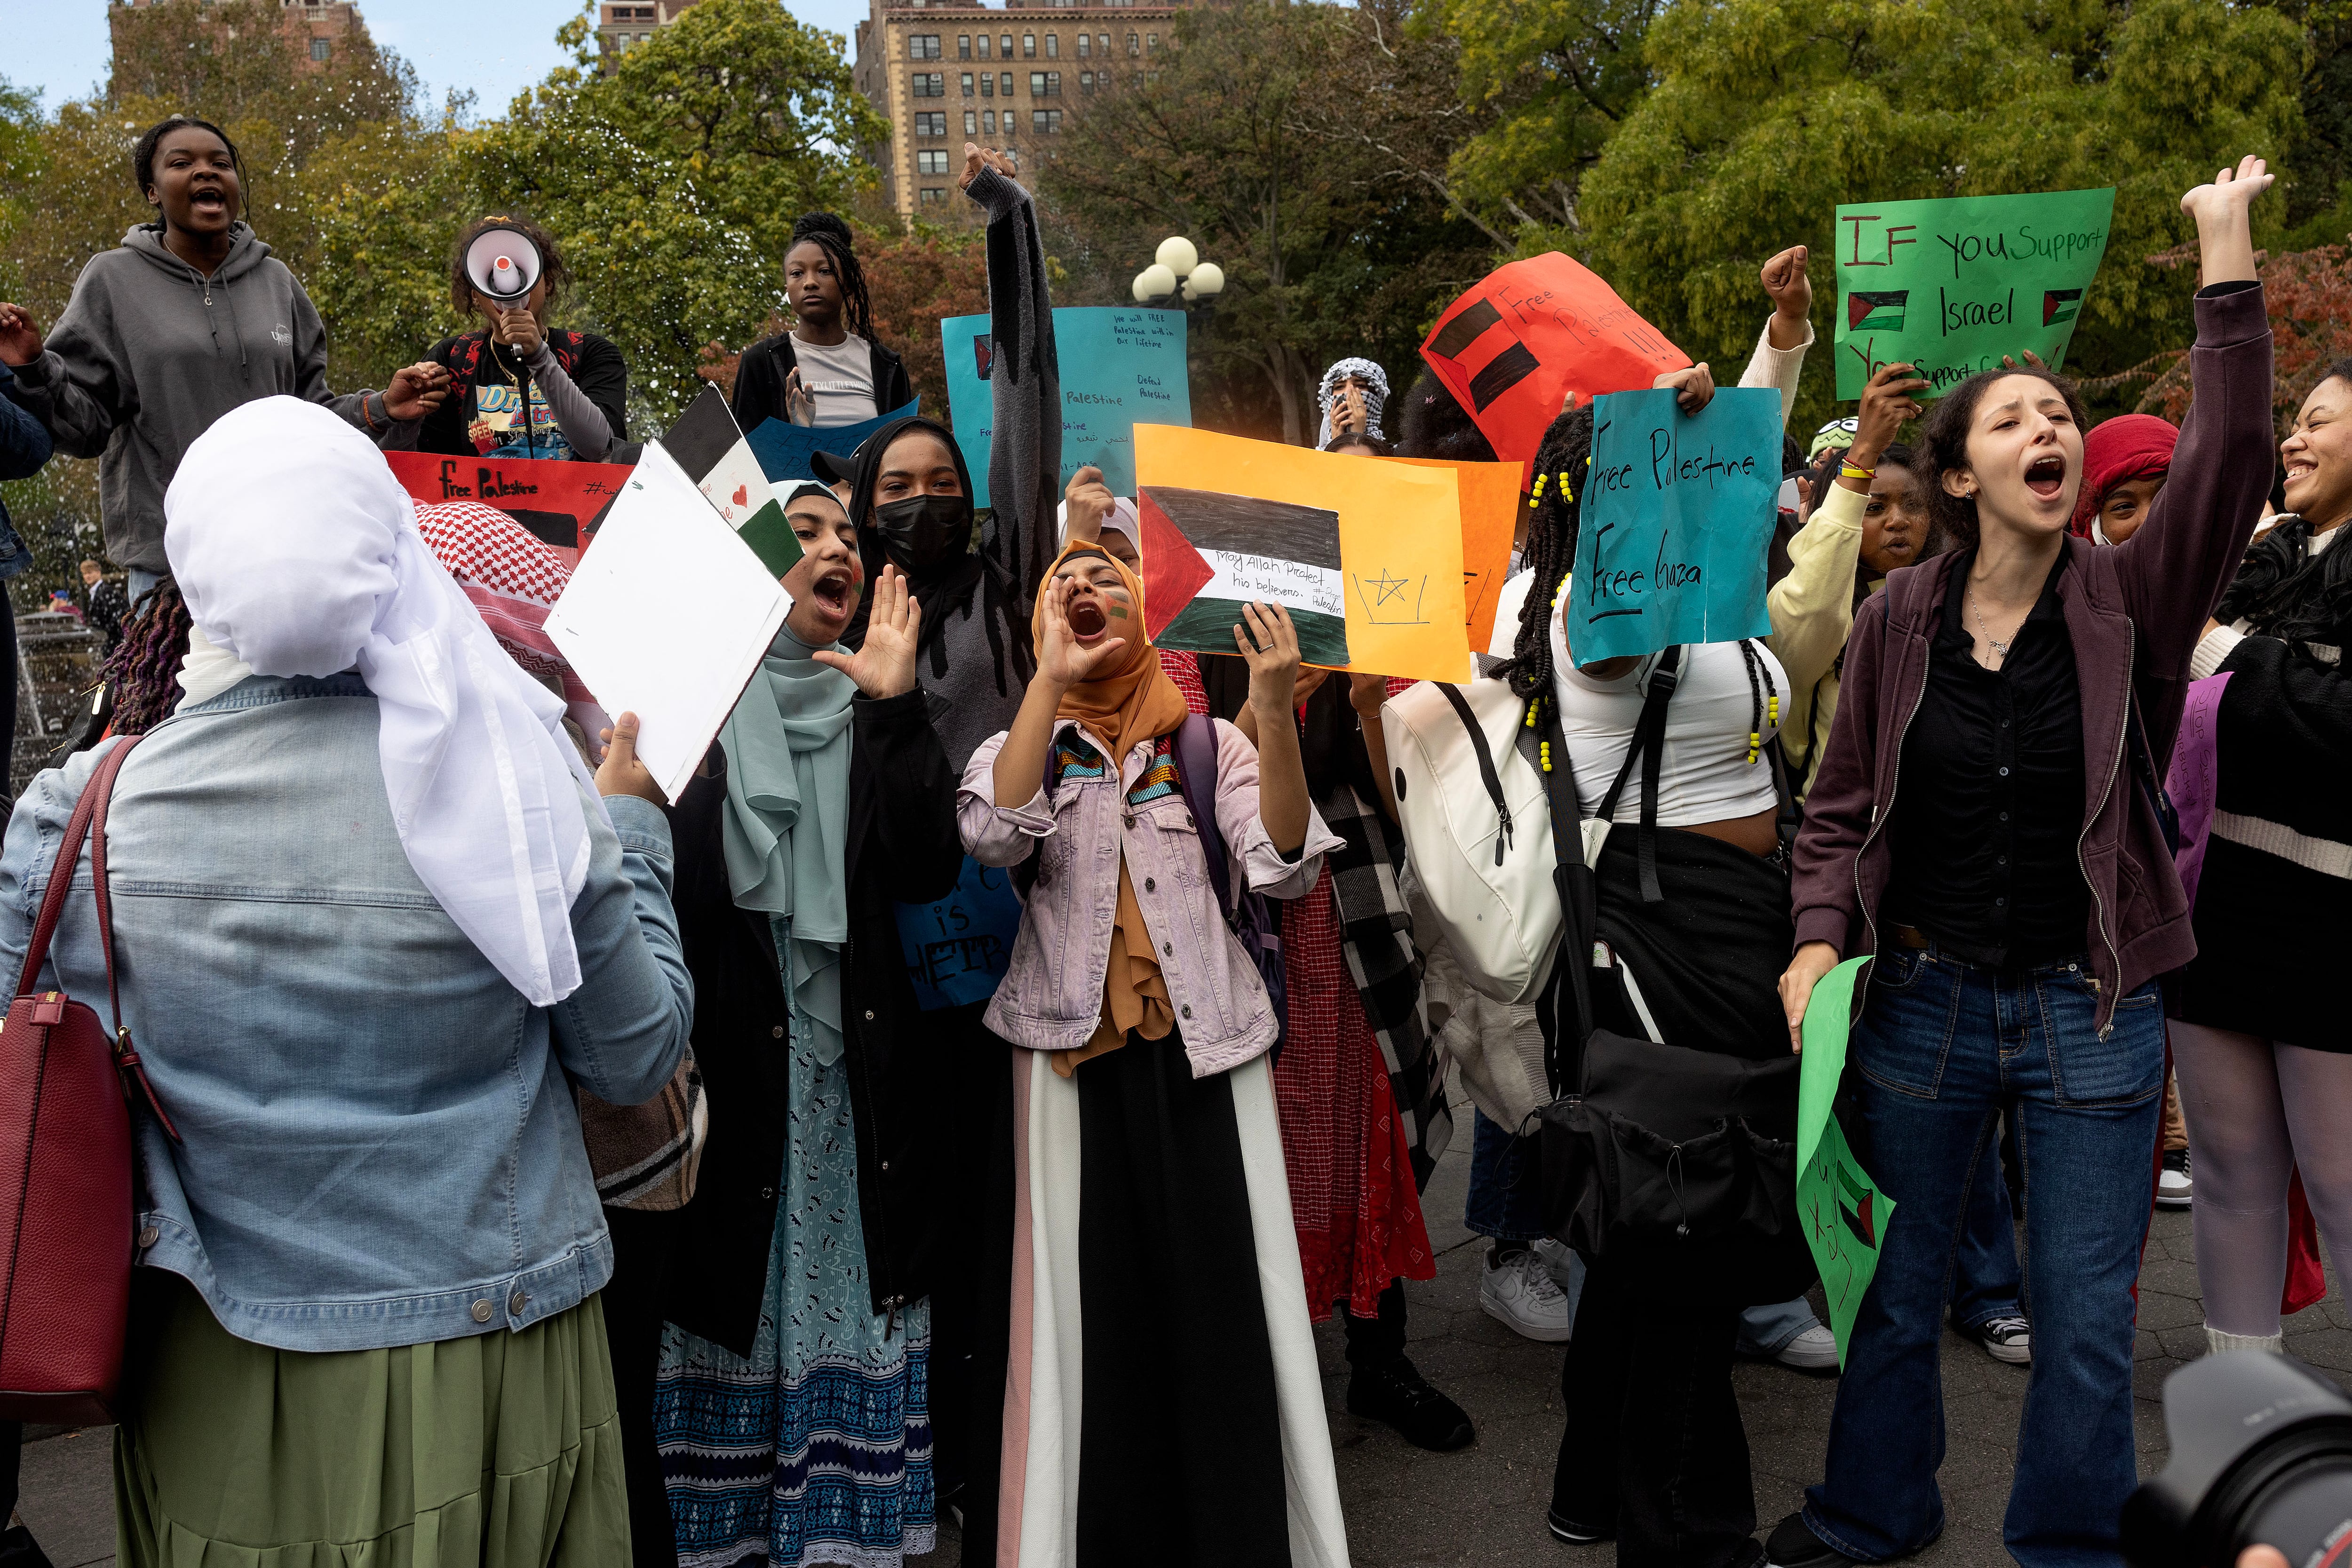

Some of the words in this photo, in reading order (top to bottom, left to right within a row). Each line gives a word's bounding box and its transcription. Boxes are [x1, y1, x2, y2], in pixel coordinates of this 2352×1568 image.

[1840, 215, 1917, 266] IF
[2010, 225, 2103, 262] Support
[1498, 286, 1554, 324] Free
[1939, 287, 2014, 337] Israel
[1113, 314, 1125, 324] We
[1148, 313, 1165, 322] FREE
[1553, 304, 1637, 346] Palestine
[1113, 326, 1146, 335] Palestine
[1151, 326, 1174, 336] within
[1135, 337, 1162, 348] lifetime
[1137, 374, 1161, 386] Defend
[1066, 390, 1123, 406] Palestine
[1139, 387, 1170, 401] Palestine
[508, 425, 551, 441] Stating
[980, 428, 992, 437] Fre
[1062, 422, 1087, 430] stine
[775, 433, 862, 455] FREE
[1589, 420, 1633, 506] Free
[1649, 427, 1756, 490] Palestine
[438, 460, 472, 500] Free
[477, 467, 539, 499] Palestine
[1215, 550, 1243, 572] May
[1246, 557, 1280, 574] Allah
[1590, 522, 1645, 606] Free
[1654, 528, 1701, 590] Gaza
[1233, 572, 1250, 588] his
[2194, 687, 2217, 739] STOP
[933, 905, 969, 936] is
